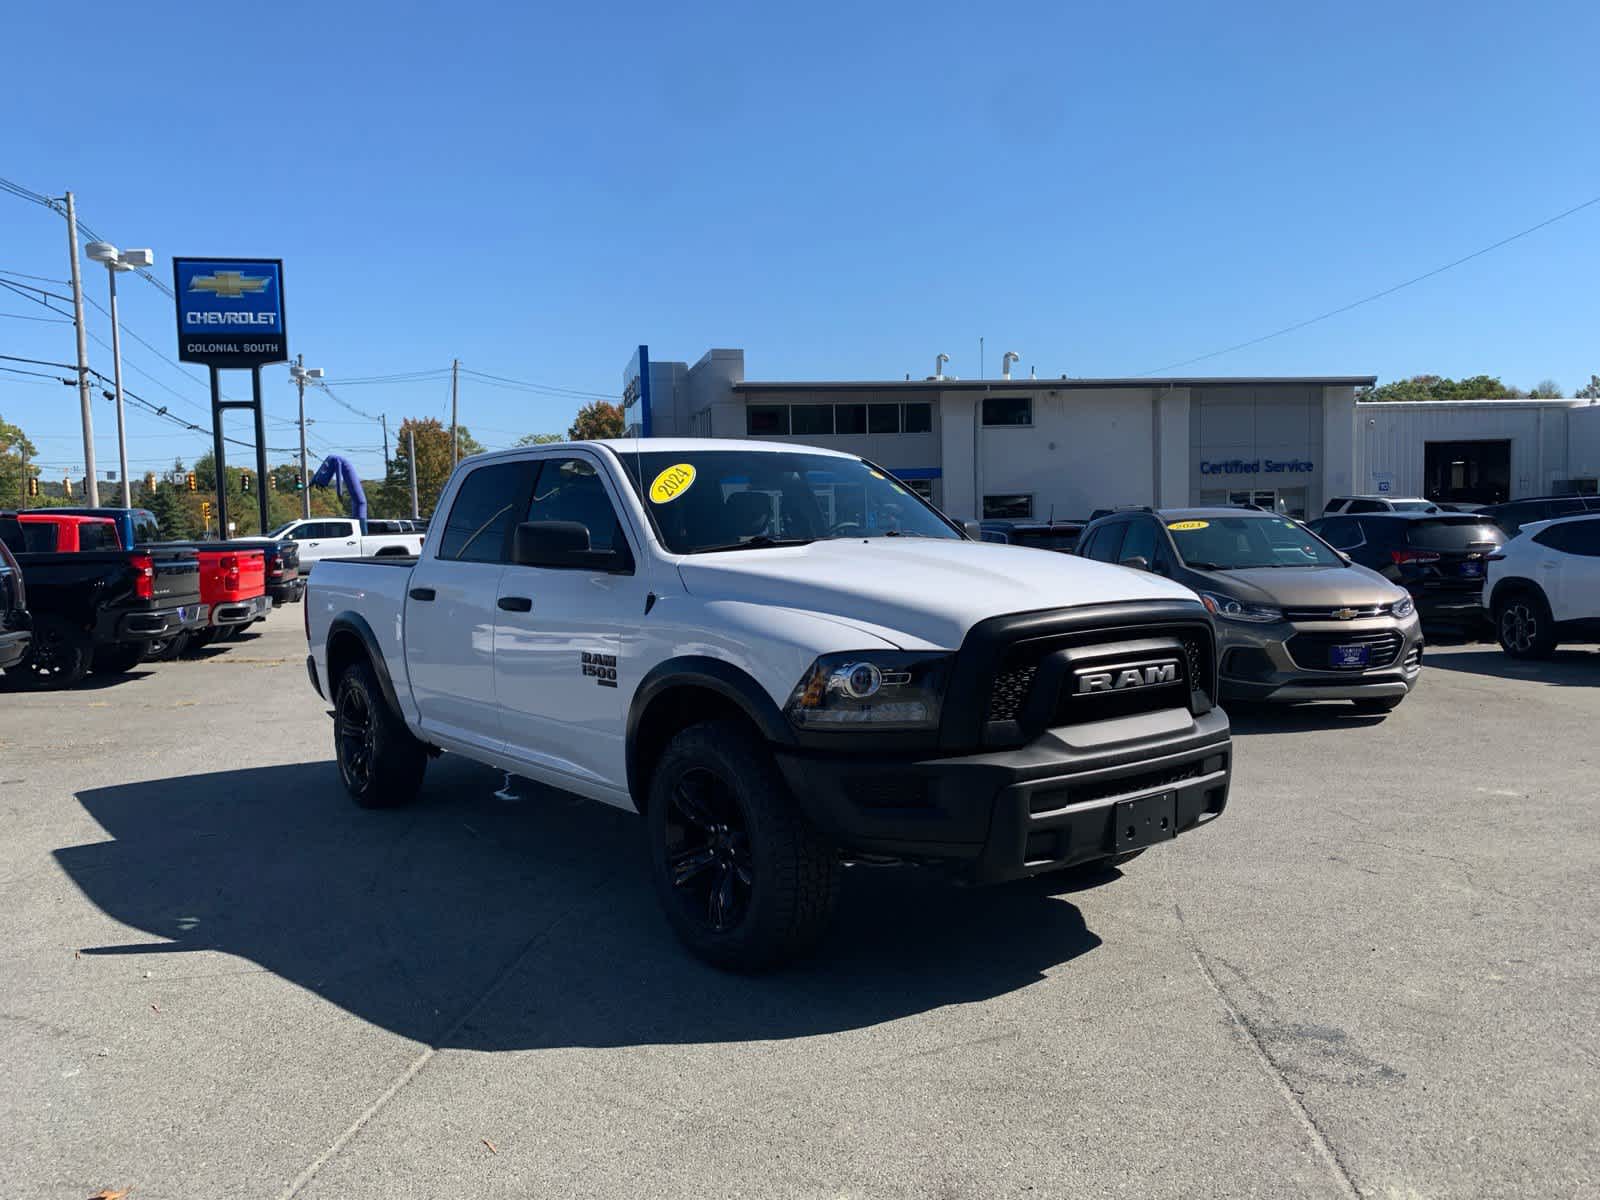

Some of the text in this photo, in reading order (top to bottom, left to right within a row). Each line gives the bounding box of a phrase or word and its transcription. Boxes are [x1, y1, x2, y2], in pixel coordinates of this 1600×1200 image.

[186, 311, 276, 325] CHEVROLET
[187, 343, 279, 353] COLONIAL SOUTH
[1200, 459, 1313, 474] Certified Service
[658, 468, 689, 497] 2024
[581, 651, 617, 668] RAM
[582, 664, 617, 680] 1500
[1079, 664, 1175, 692] RAM
